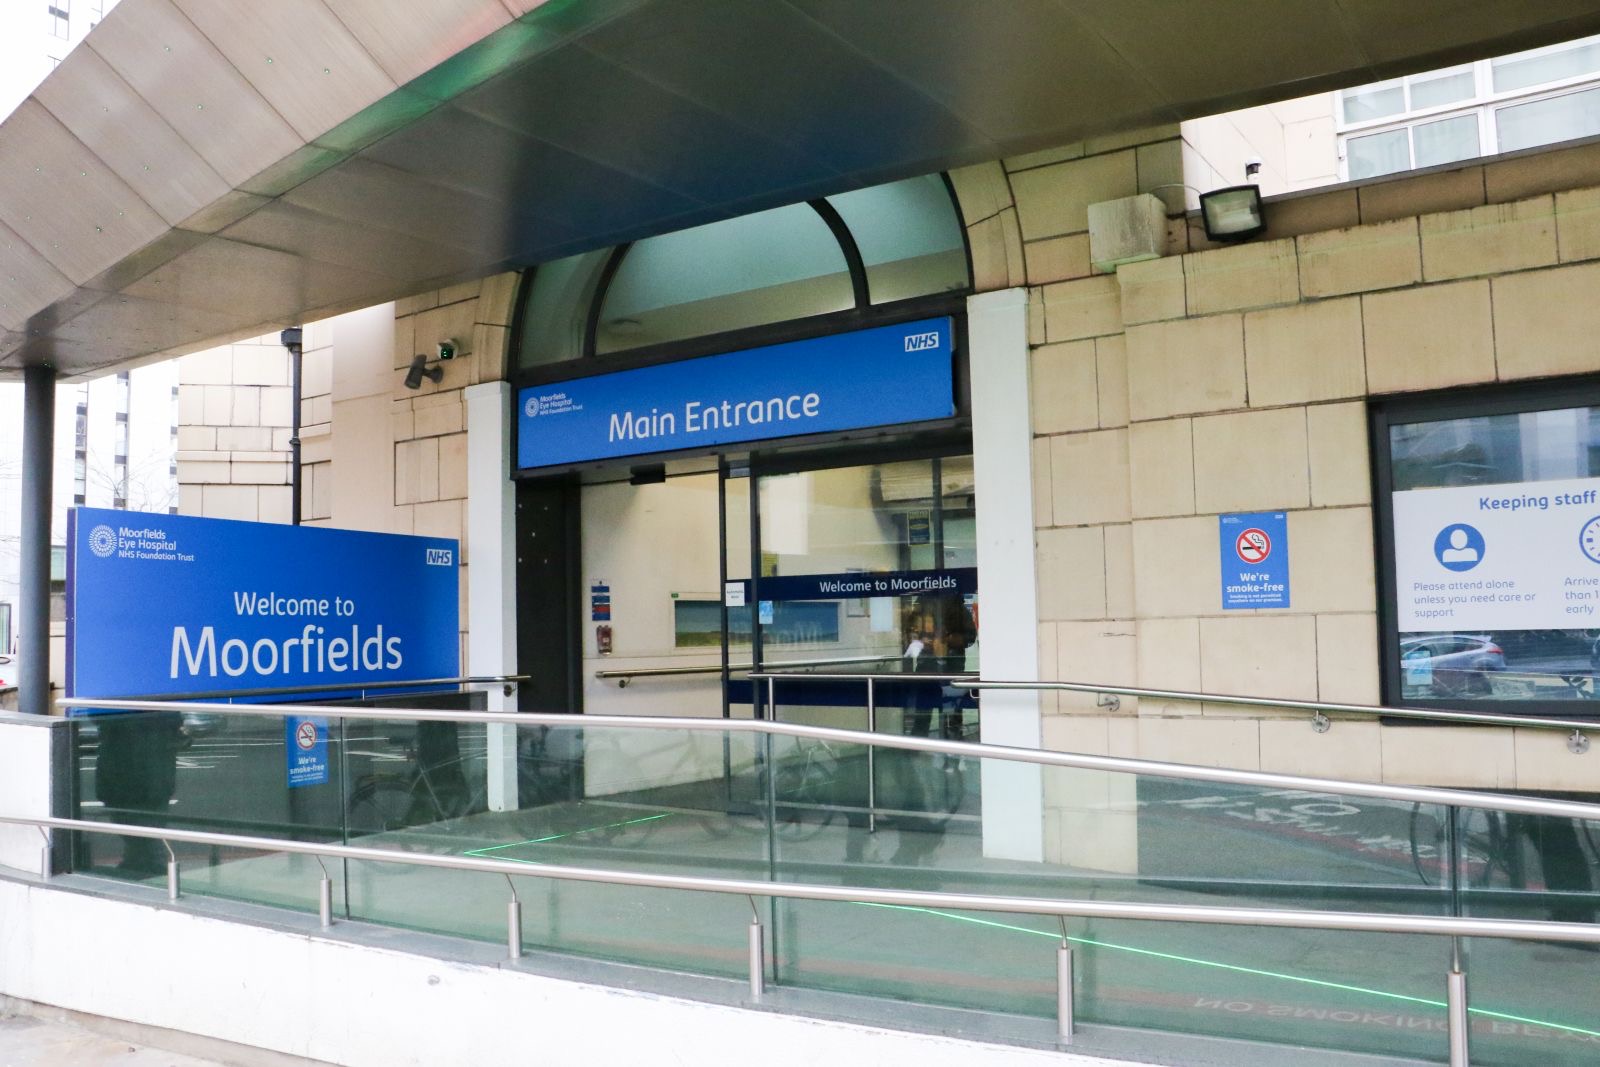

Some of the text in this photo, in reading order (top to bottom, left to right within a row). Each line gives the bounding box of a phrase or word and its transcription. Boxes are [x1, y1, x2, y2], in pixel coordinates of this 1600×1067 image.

[905, 333, 938, 351] NHS
[609, 392, 820, 442] Main Entrance
[1479, 489, 1597, 511] Keeping staff
[119, 527, 166, 540] Moorfields
[118, 538, 177, 552] Eye Hospital
[118, 550, 195, 562] NHS Foundation Trust
[427, 550, 451, 565] NHS
[1240, 572, 1270, 582] We're
[1564, 576, 1599, 586] Arrive
[819, 576, 957, 593] Welcome to Moorfields
[1226, 582, 1284, 593] smoke-free
[1413, 580, 1515, 591] Please attend alone
[1414, 594, 1536, 606] unless you need care or
[1565, 590, 1591, 600] than
[234, 591, 355, 617] Welcome to
[1566, 604, 1594, 615] early
[1414, 608, 1454, 618] support
[170, 624, 403, 679] Moorfields
